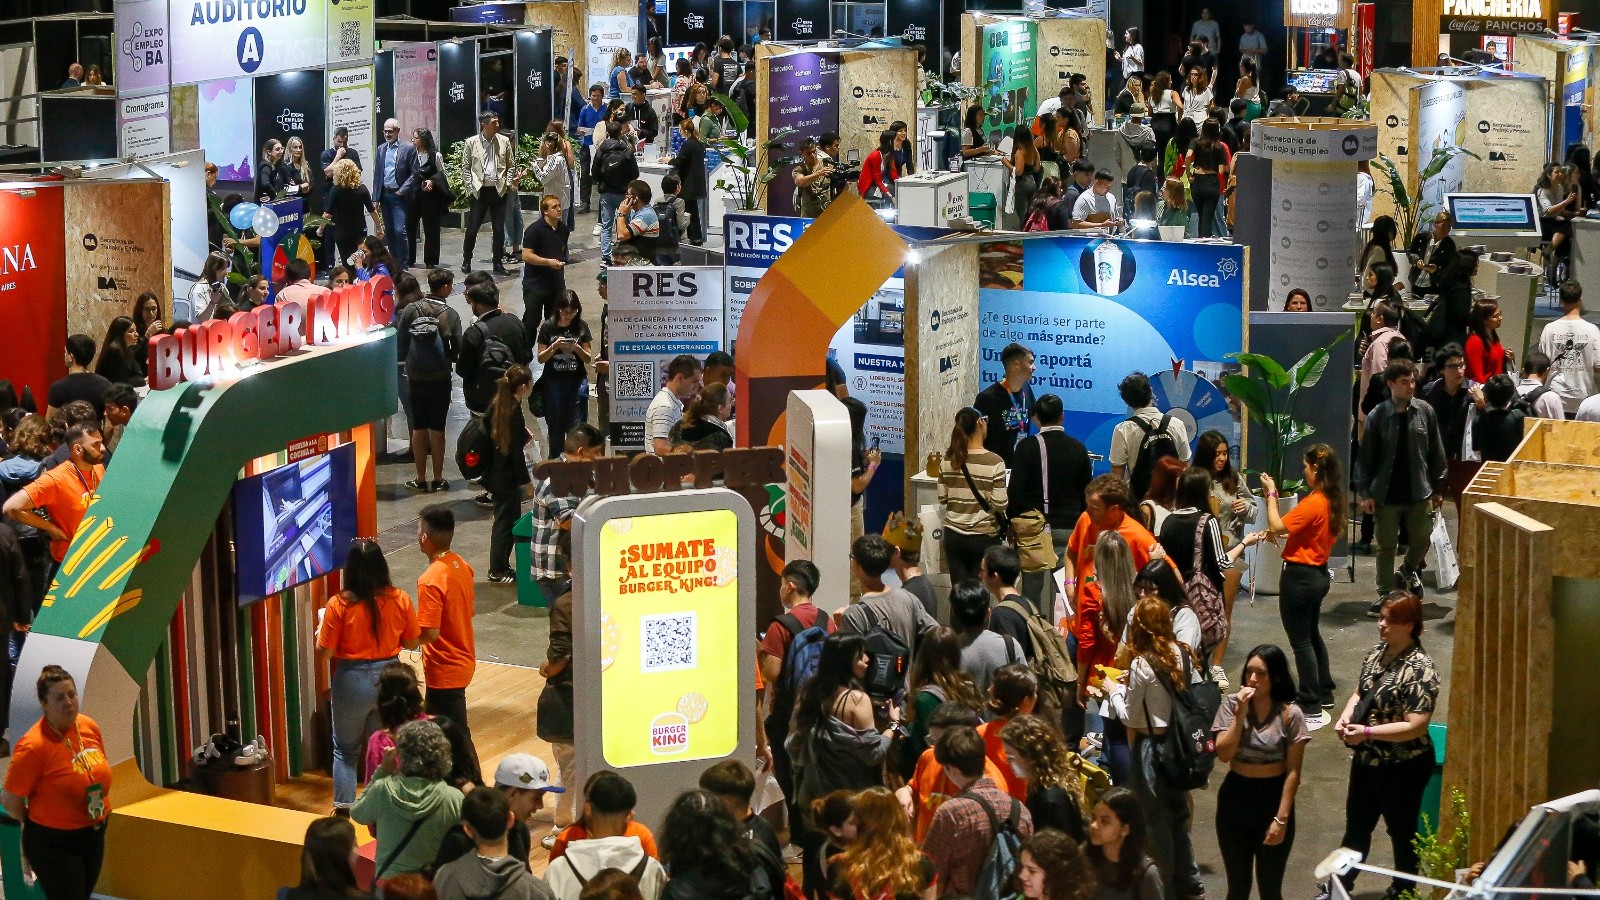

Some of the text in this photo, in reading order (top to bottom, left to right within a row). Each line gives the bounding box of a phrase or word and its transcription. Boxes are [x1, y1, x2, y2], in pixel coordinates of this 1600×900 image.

[190, 0, 306, 26] AUDITORIO
[144, 28, 164, 38] EXPO
[1486, 20, 1543, 32] PANCHOS
[135, 40, 164, 50] EMPLEO
[242, 34, 260, 63] A
[146, 50, 164, 66] BA
[333, 73, 368, 84] Cronograma
[126, 101, 164, 113] Cronograma
[1264, 144, 1288, 154] Trabajo
[1298, 147, 1329, 156] Empleo
[1489, 152, 1506, 161] BA
[729, 220, 794, 252] RES
[0, 243, 37, 275] NA
[98, 277, 117, 290] BA
[632, 272, 698, 298] RES
[734, 281, 757, 289] SOBR
[1167, 268, 1220, 288] Alsea
[982, 312, 1106, 330] ¿Te gustaría ser parte
[149, 274, 394, 390] BURGER KING
[982, 327, 1106, 345] de algo más grande?
[858, 358, 898, 367] NUESTRA
[1040, 353, 1092, 369] aportá
[982, 369, 998, 382] tu
[1049, 373, 1092, 389] único
[619, 539, 715, 569] ¡SUMATE
[619, 558, 716, 583] AL EQUIPO
[619, 575, 718, 595] BURGER KING!
[652, 725, 686, 735] BURGER
[652, 734, 686, 746] KING
